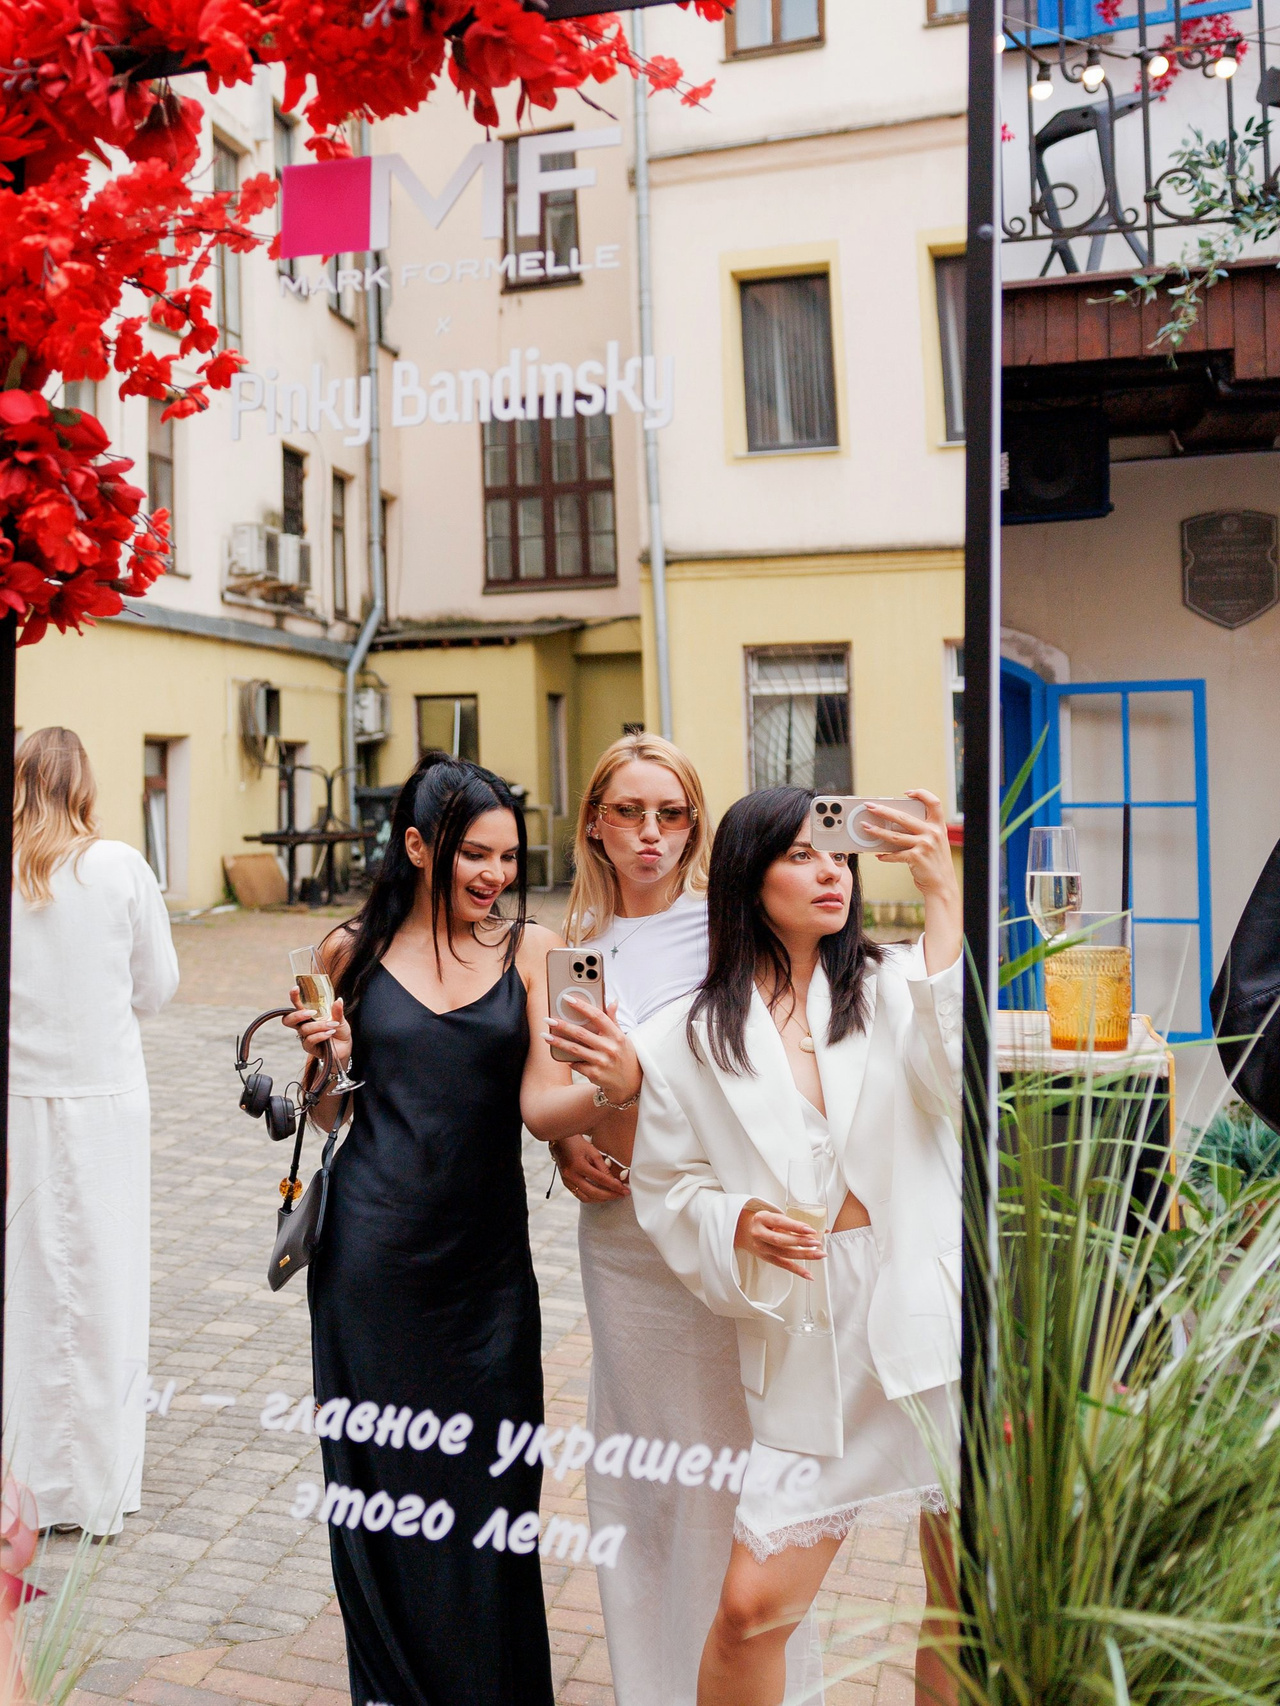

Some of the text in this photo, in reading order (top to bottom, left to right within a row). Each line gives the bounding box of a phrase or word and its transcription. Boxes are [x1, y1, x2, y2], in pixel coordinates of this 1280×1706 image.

[370, 127, 622, 250] MF
[279, 244, 621, 298] MARK FORMELLE
[230, 340, 675, 447] Pinky Bandinsky
[260, 1390, 473, 1457] главное
[290, 1480, 628, 1570] этого лета
